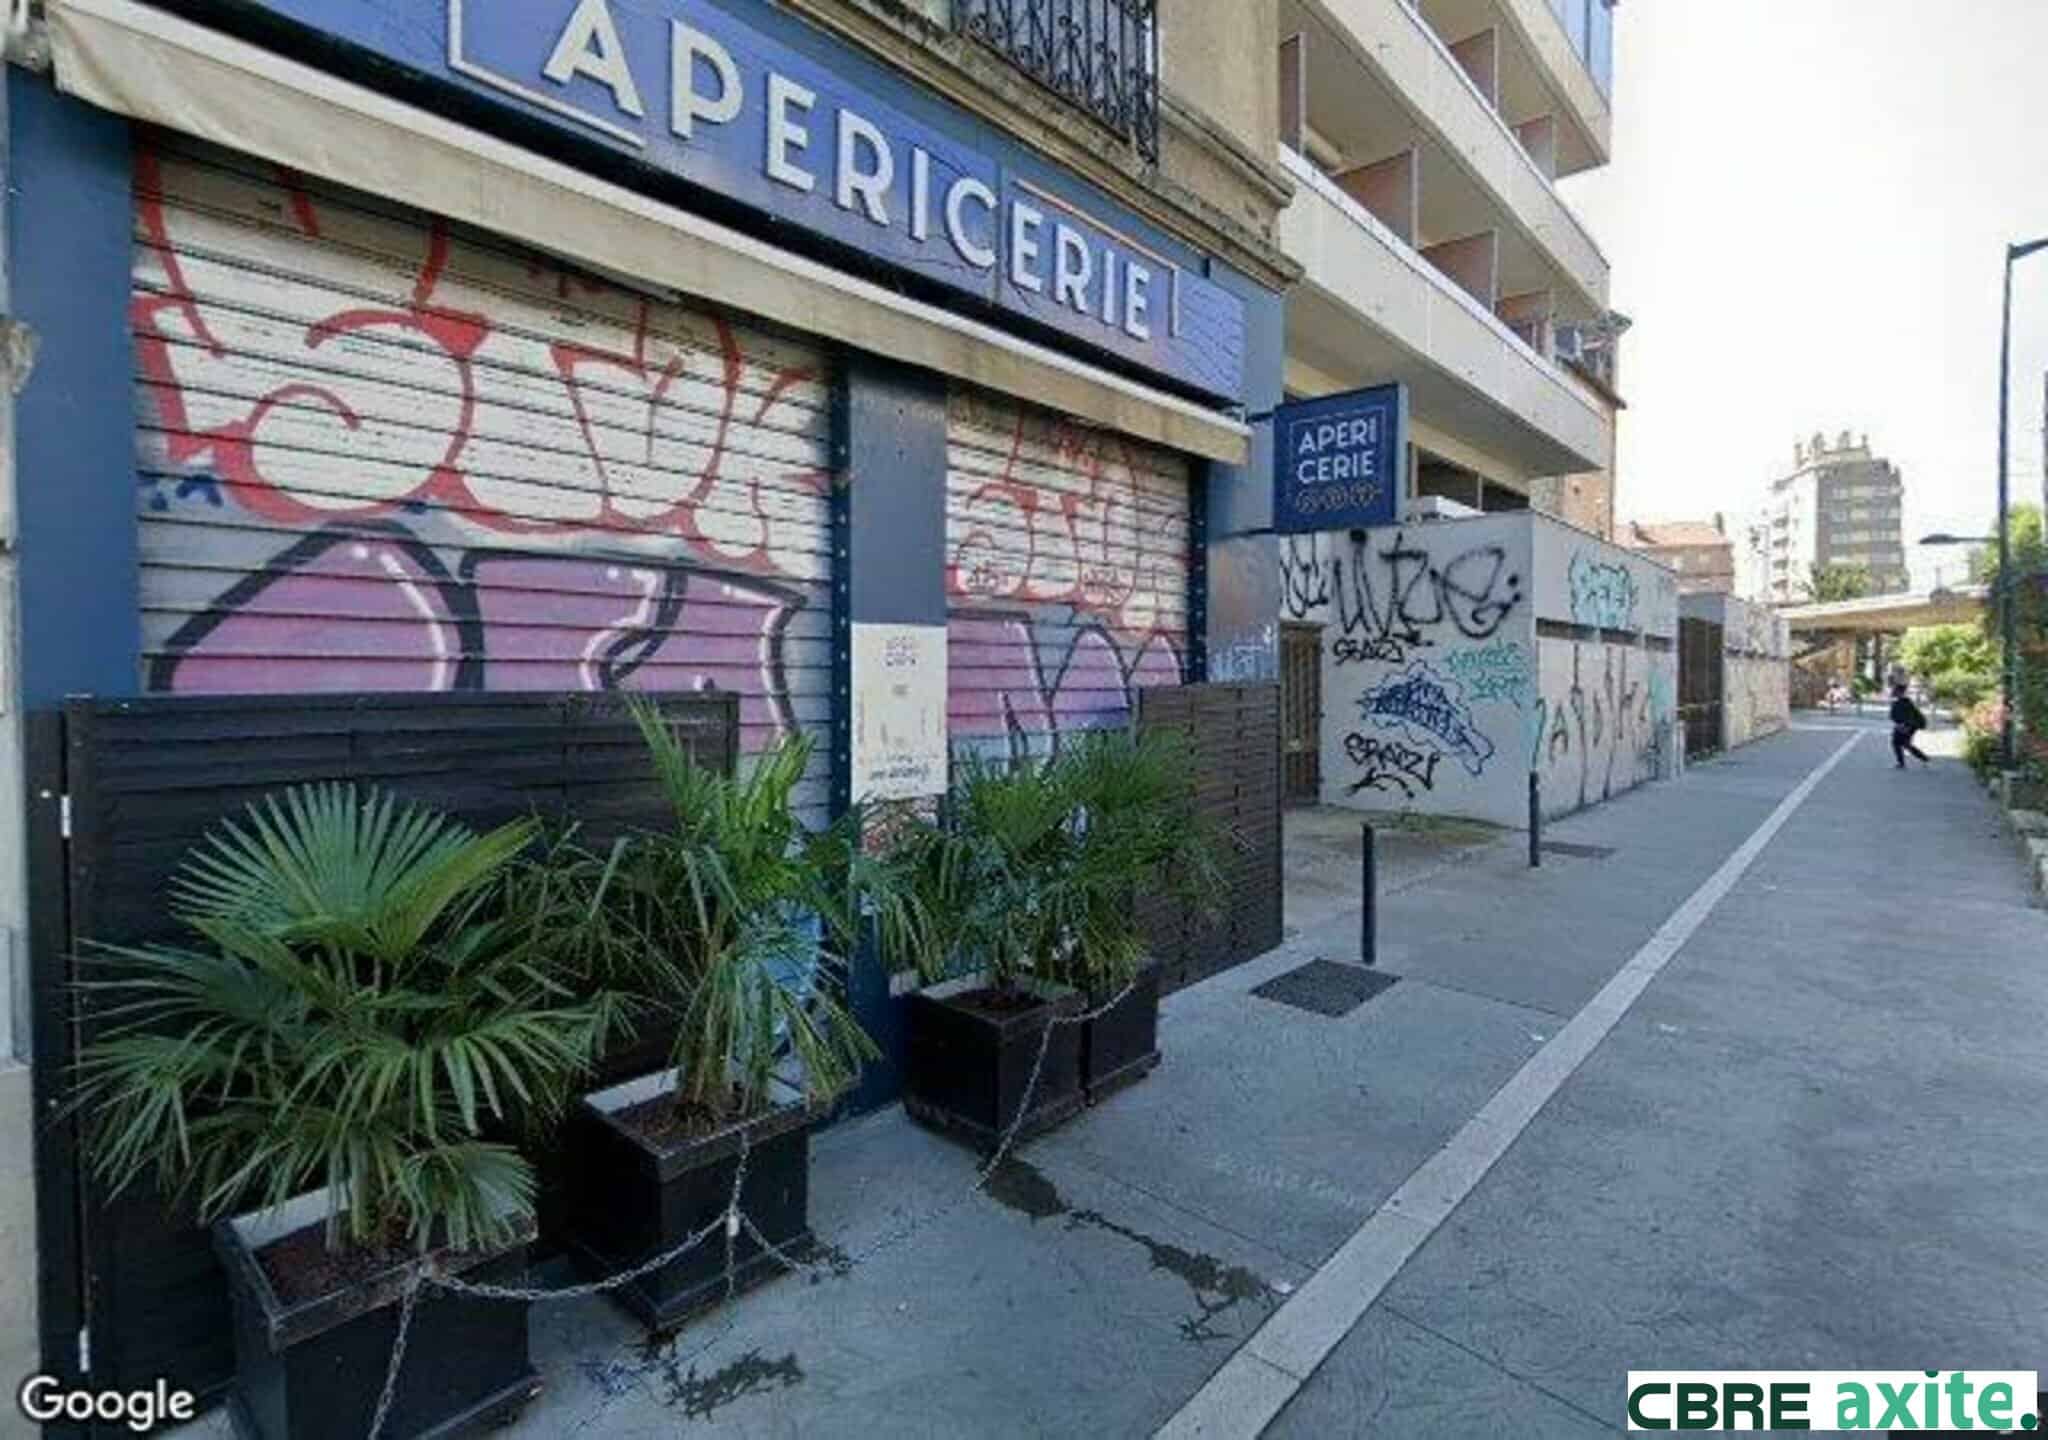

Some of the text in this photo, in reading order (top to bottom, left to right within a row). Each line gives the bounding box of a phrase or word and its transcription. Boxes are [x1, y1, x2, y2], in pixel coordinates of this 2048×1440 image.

[543, 0, 1151, 343] APERICERIE
[1298, 417, 1377, 455] APERI
[1297, 450, 1375, 484] CERIE
